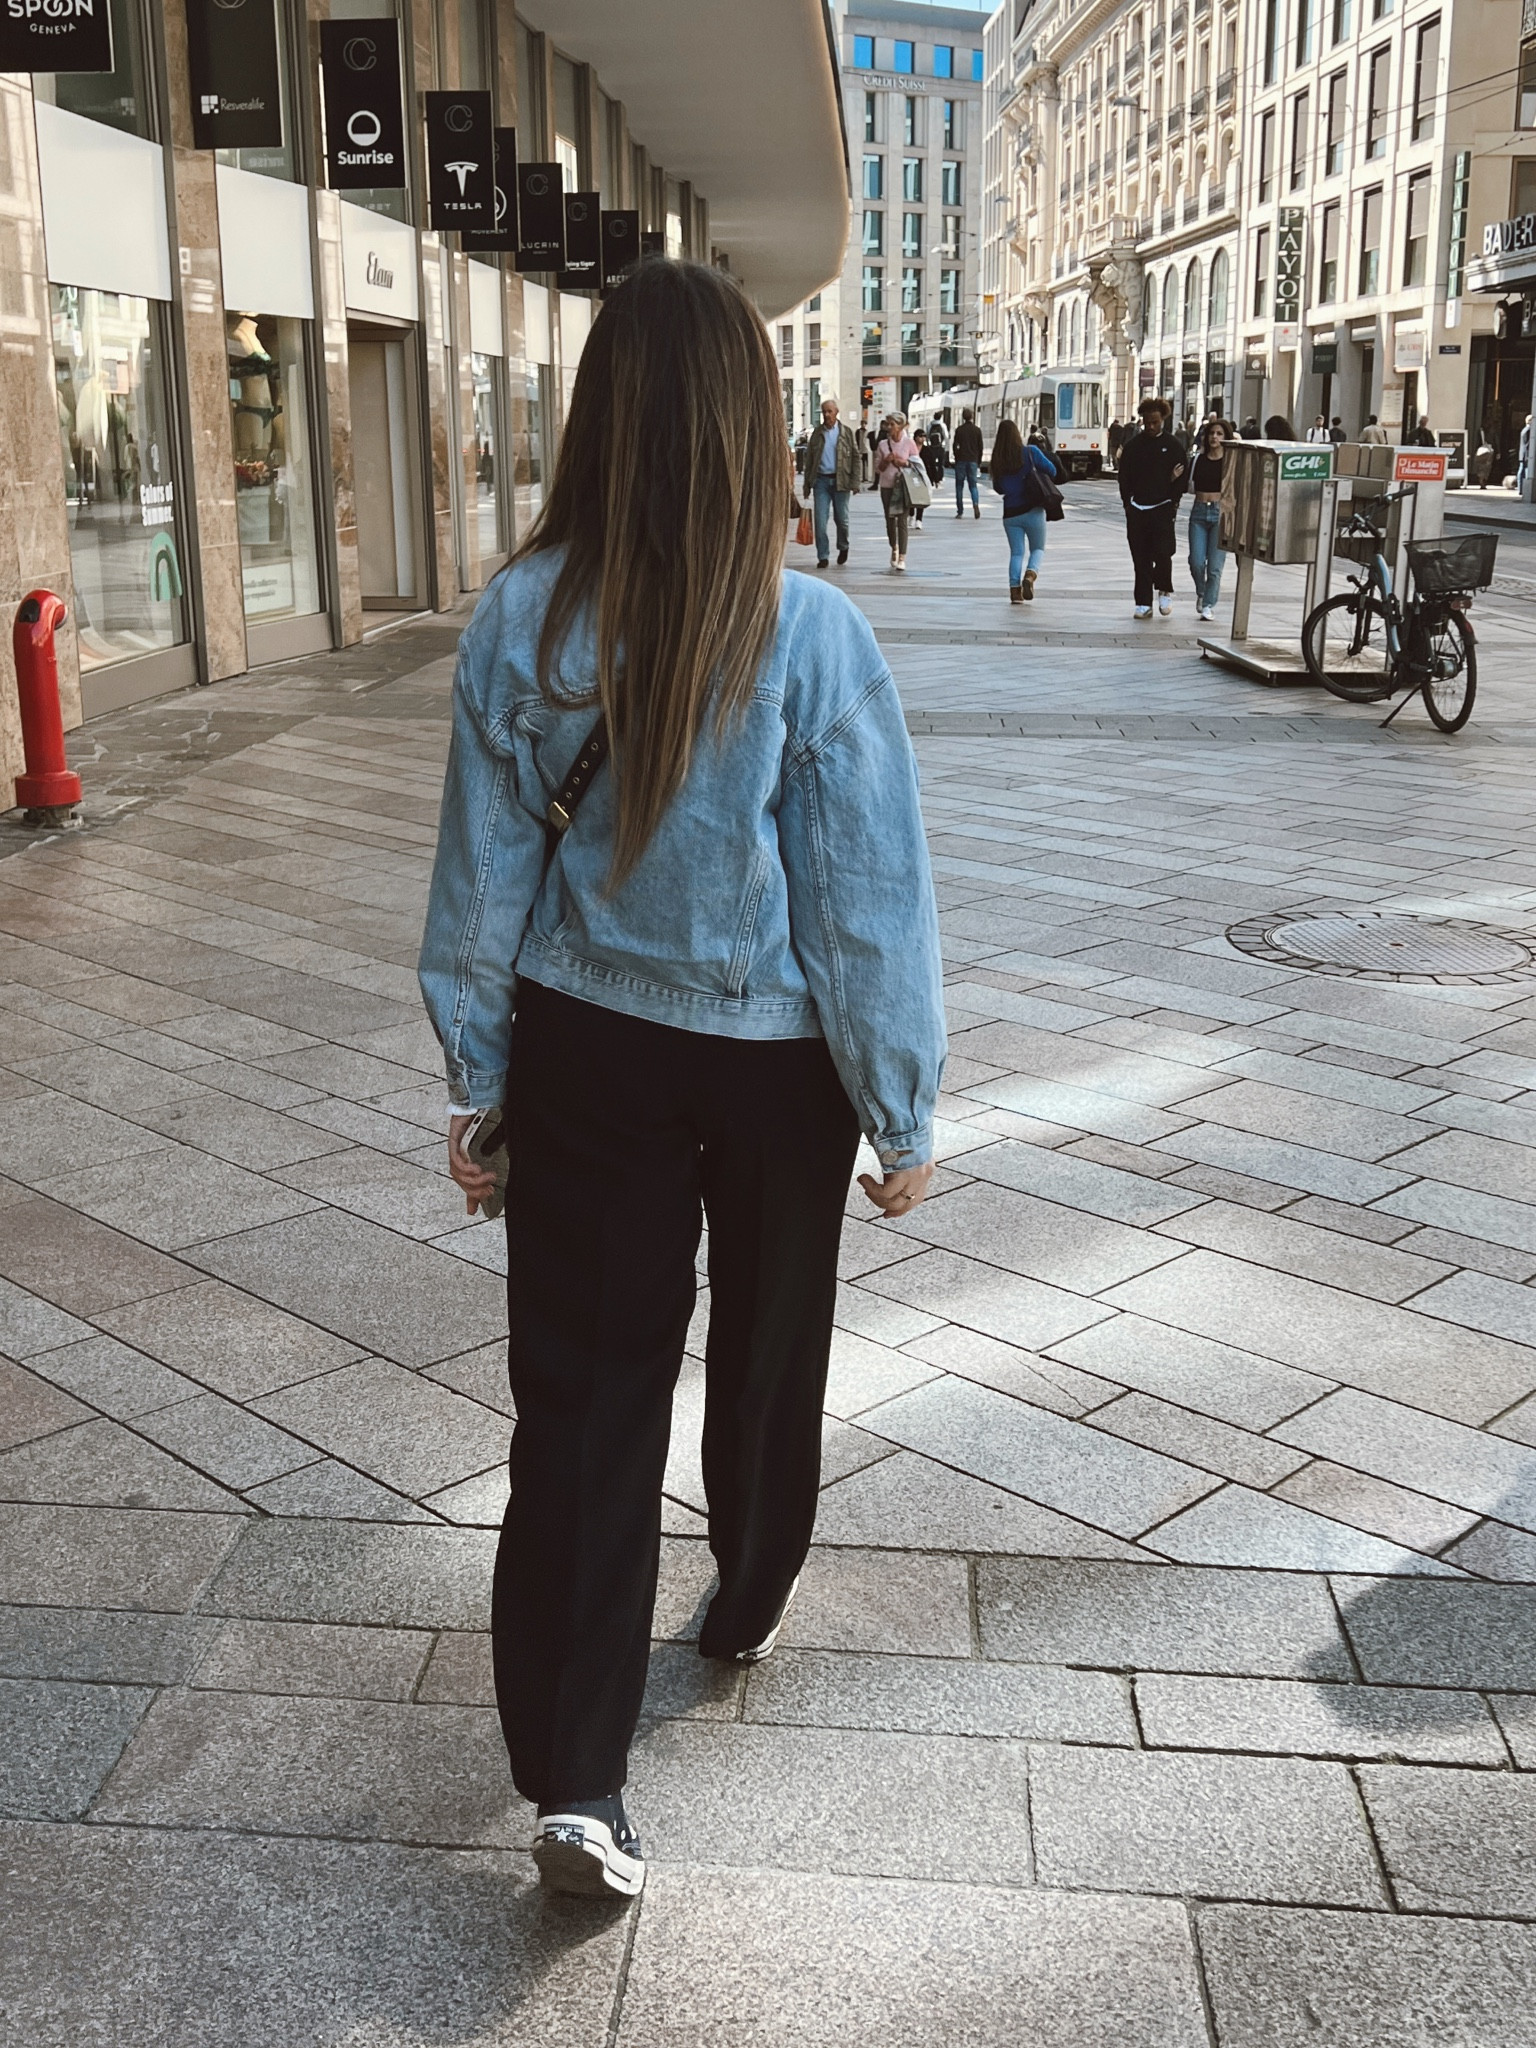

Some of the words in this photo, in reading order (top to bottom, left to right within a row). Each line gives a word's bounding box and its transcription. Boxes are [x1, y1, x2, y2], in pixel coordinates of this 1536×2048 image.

[7, 0, 94, 18] SPOON
[29, 22, 77, 35] GENEVA
[337, 149, 395, 165] Sunrise
[443, 202, 482, 210] TESLA
[1483, 213, 1535, 256] BADER
[1278, 208, 1300, 321] PAYOT
[1285, 455, 1321, 470] GHI
